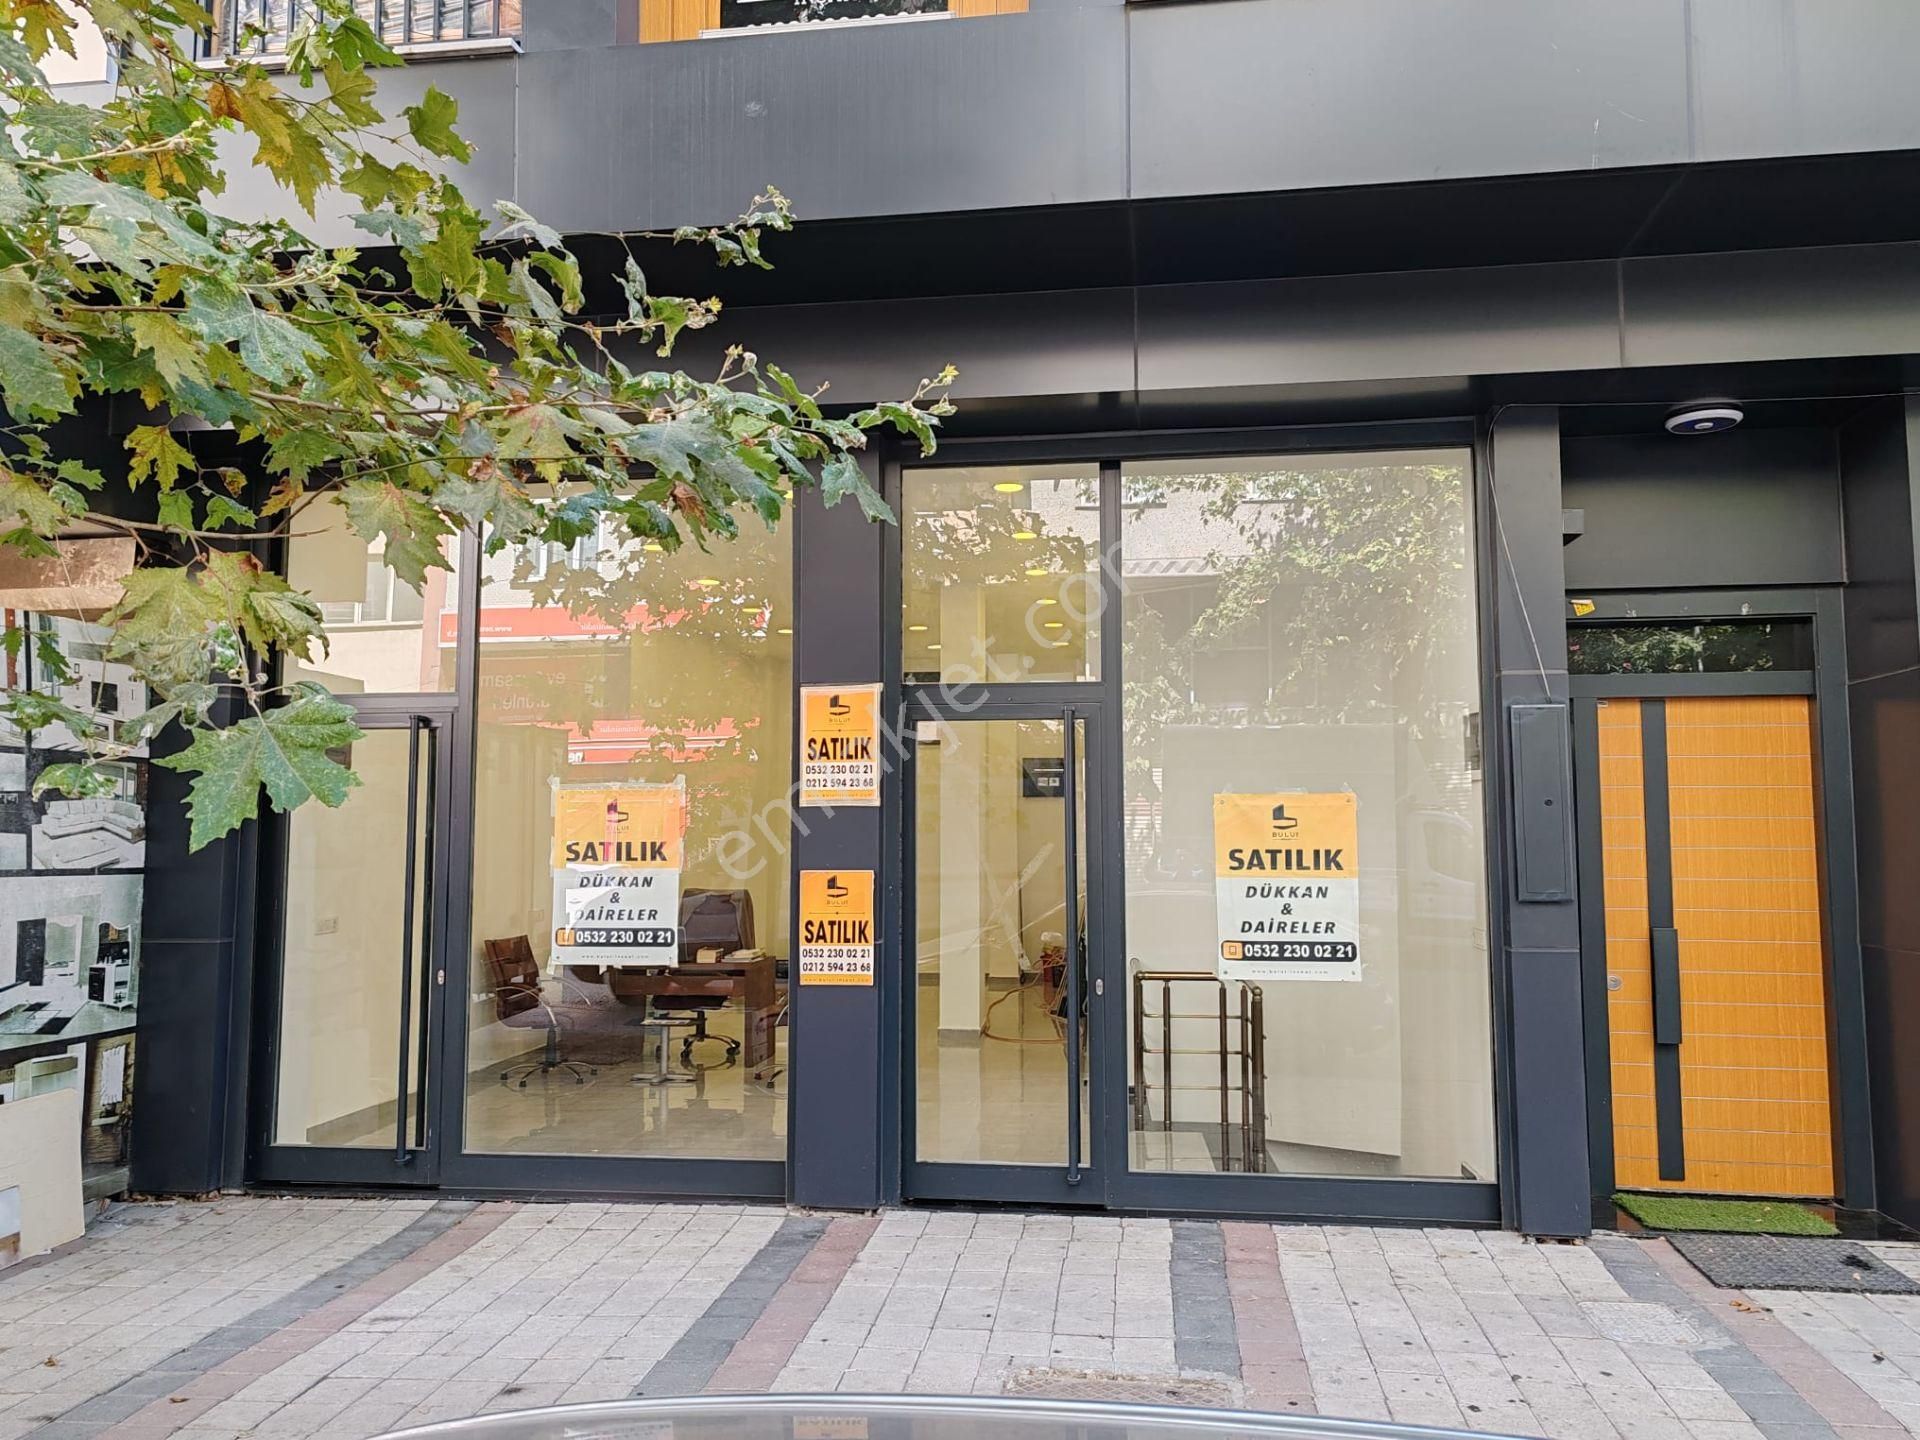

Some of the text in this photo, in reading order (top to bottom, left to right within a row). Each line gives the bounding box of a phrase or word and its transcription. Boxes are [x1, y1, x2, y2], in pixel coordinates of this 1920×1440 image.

[807, 737, 872, 761] SATILIK
[806, 764, 873, 775] 0532 230 02 21
[805, 777, 874, 788] 0212 594 23 68
[565, 841, 668, 862] SATILIK
[1228, 848, 1344, 871] SATILIK
[579, 873, 654, 888] DÜKKAN
[609, 891, 621, 903] &
[1245, 882, 1329, 899] DÜKKAN
[1280, 902, 1293, 916] &
[804, 919, 869, 944] SATILIK
[1240, 917, 1336, 934] DAİRELER
[576, 931, 672, 943] 0532 230 02 21
[802, 948, 871, 958] 0532 230 02 21
[1244, 944, 1352, 958] 0532 230 02 21
[802, 962, 871, 972] 0212 594 23 68
